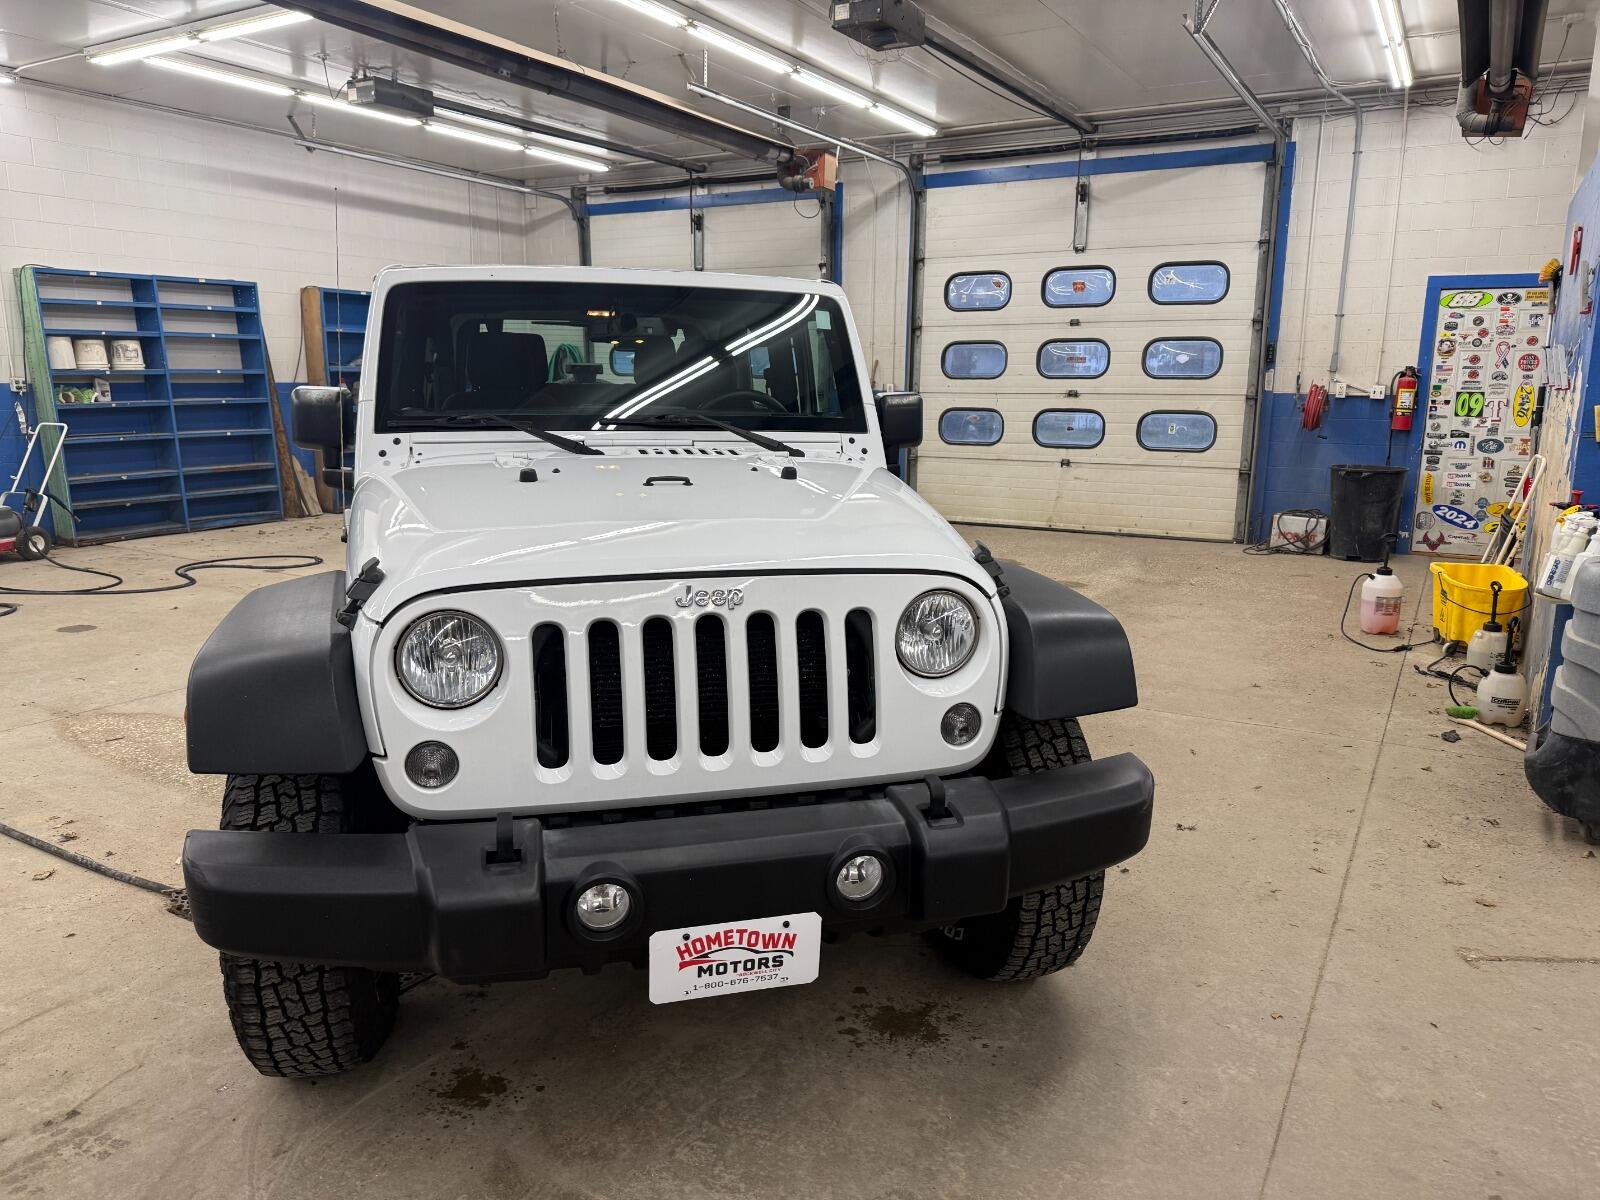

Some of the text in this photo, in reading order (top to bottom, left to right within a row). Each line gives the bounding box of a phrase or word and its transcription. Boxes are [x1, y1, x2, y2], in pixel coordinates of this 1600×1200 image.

[1456, 392, 1484, 417] 09
[1436, 506, 1477, 529] 2024
[675, 585, 744, 610] Jeep
[675, 929, 797, 961] HOMETOWN
[697, 955, 784, 978] MOTORS
